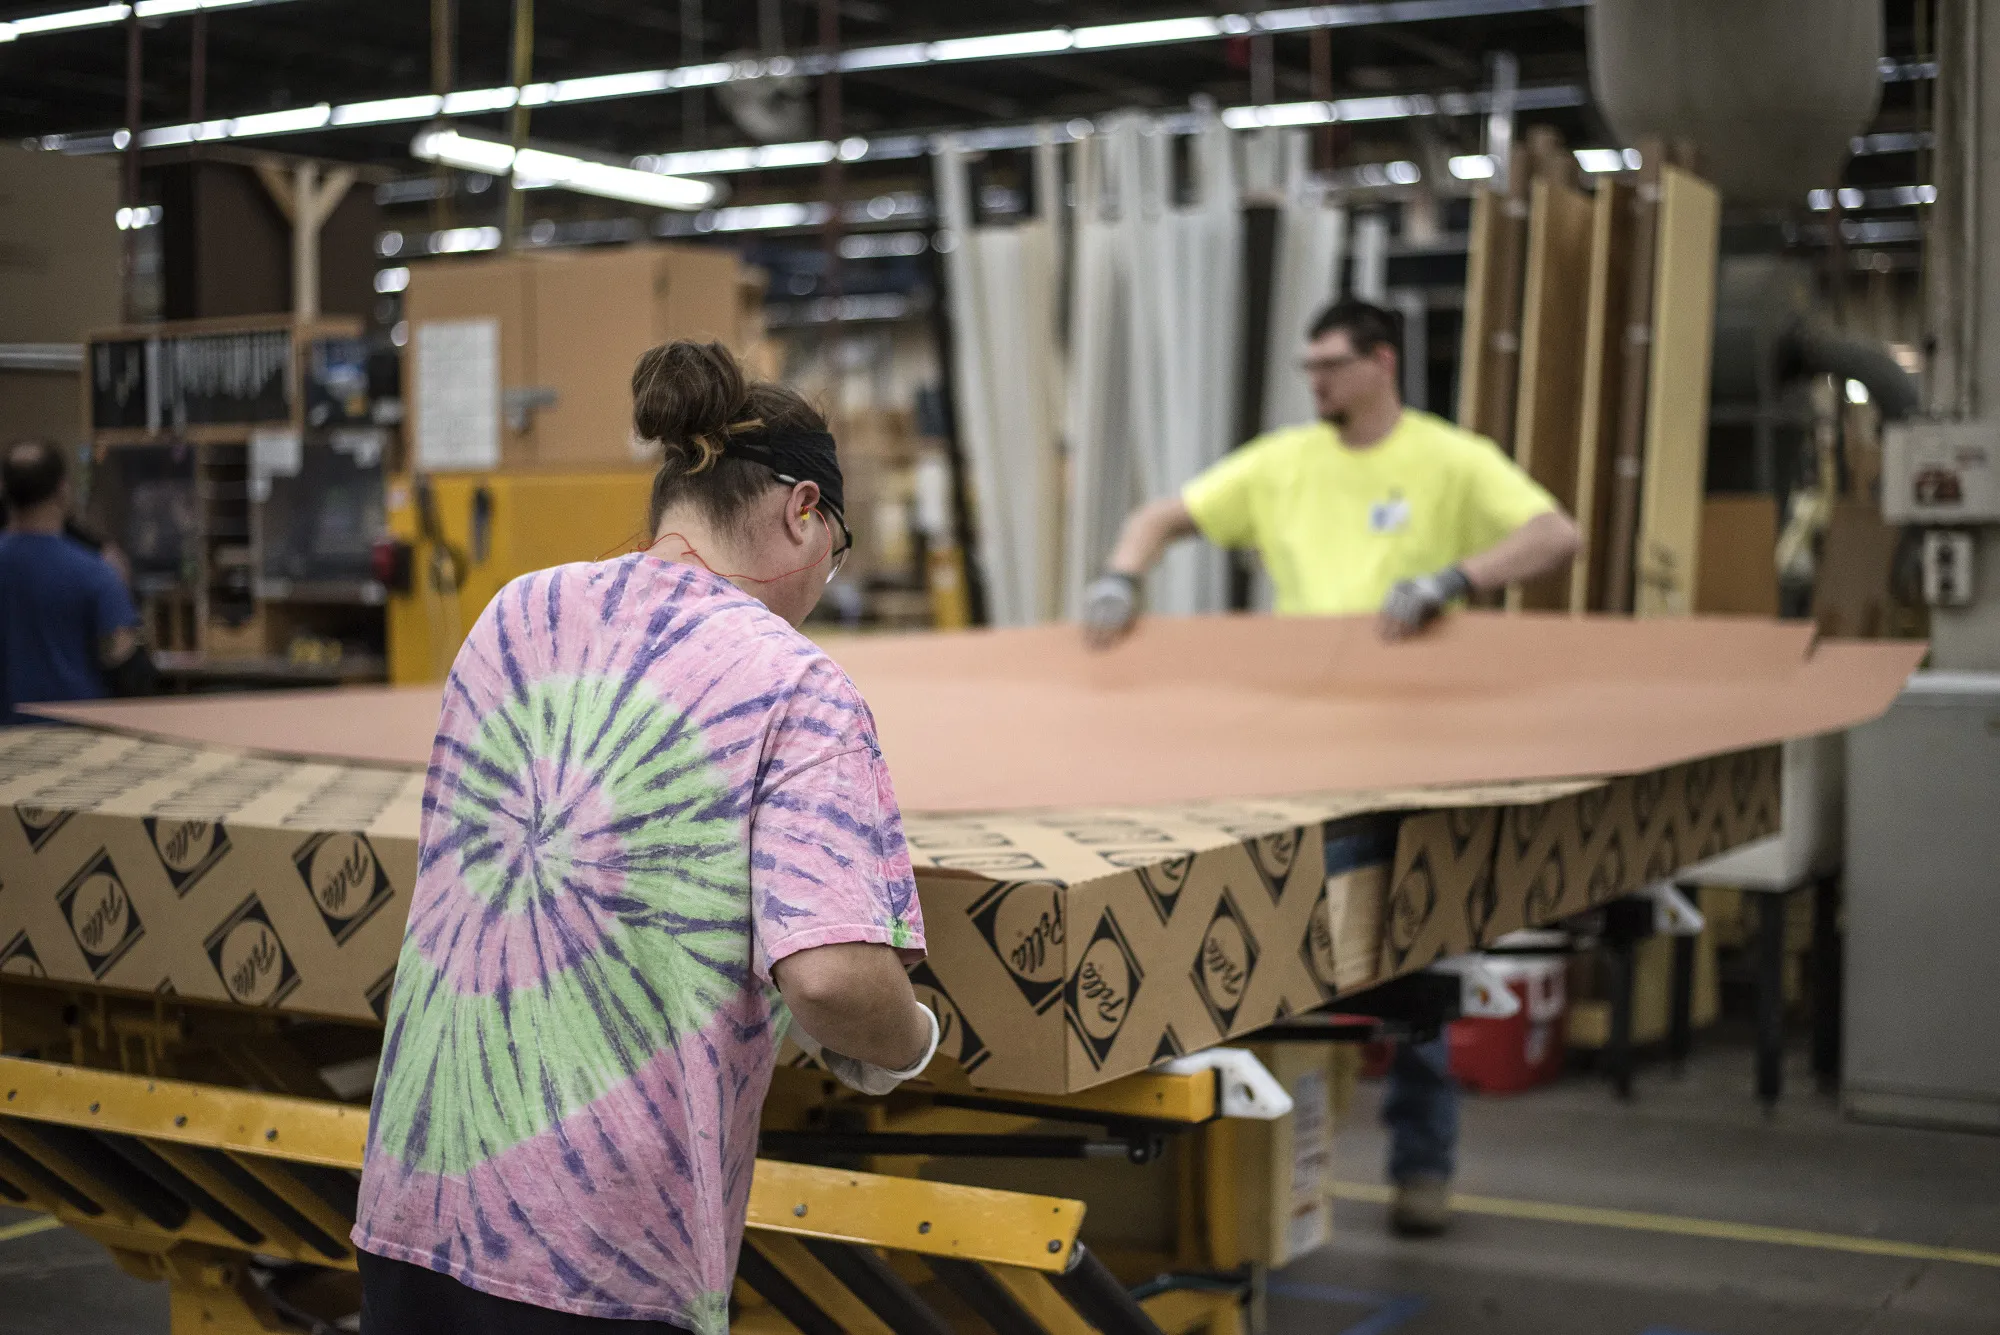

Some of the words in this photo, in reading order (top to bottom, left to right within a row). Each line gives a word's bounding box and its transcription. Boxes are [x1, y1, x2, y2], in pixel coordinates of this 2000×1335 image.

[322, 839, 369, 911] Pella
[1011, 890, 1066, 974] Pella
[1081, 961, 1125, 1023] Pella
